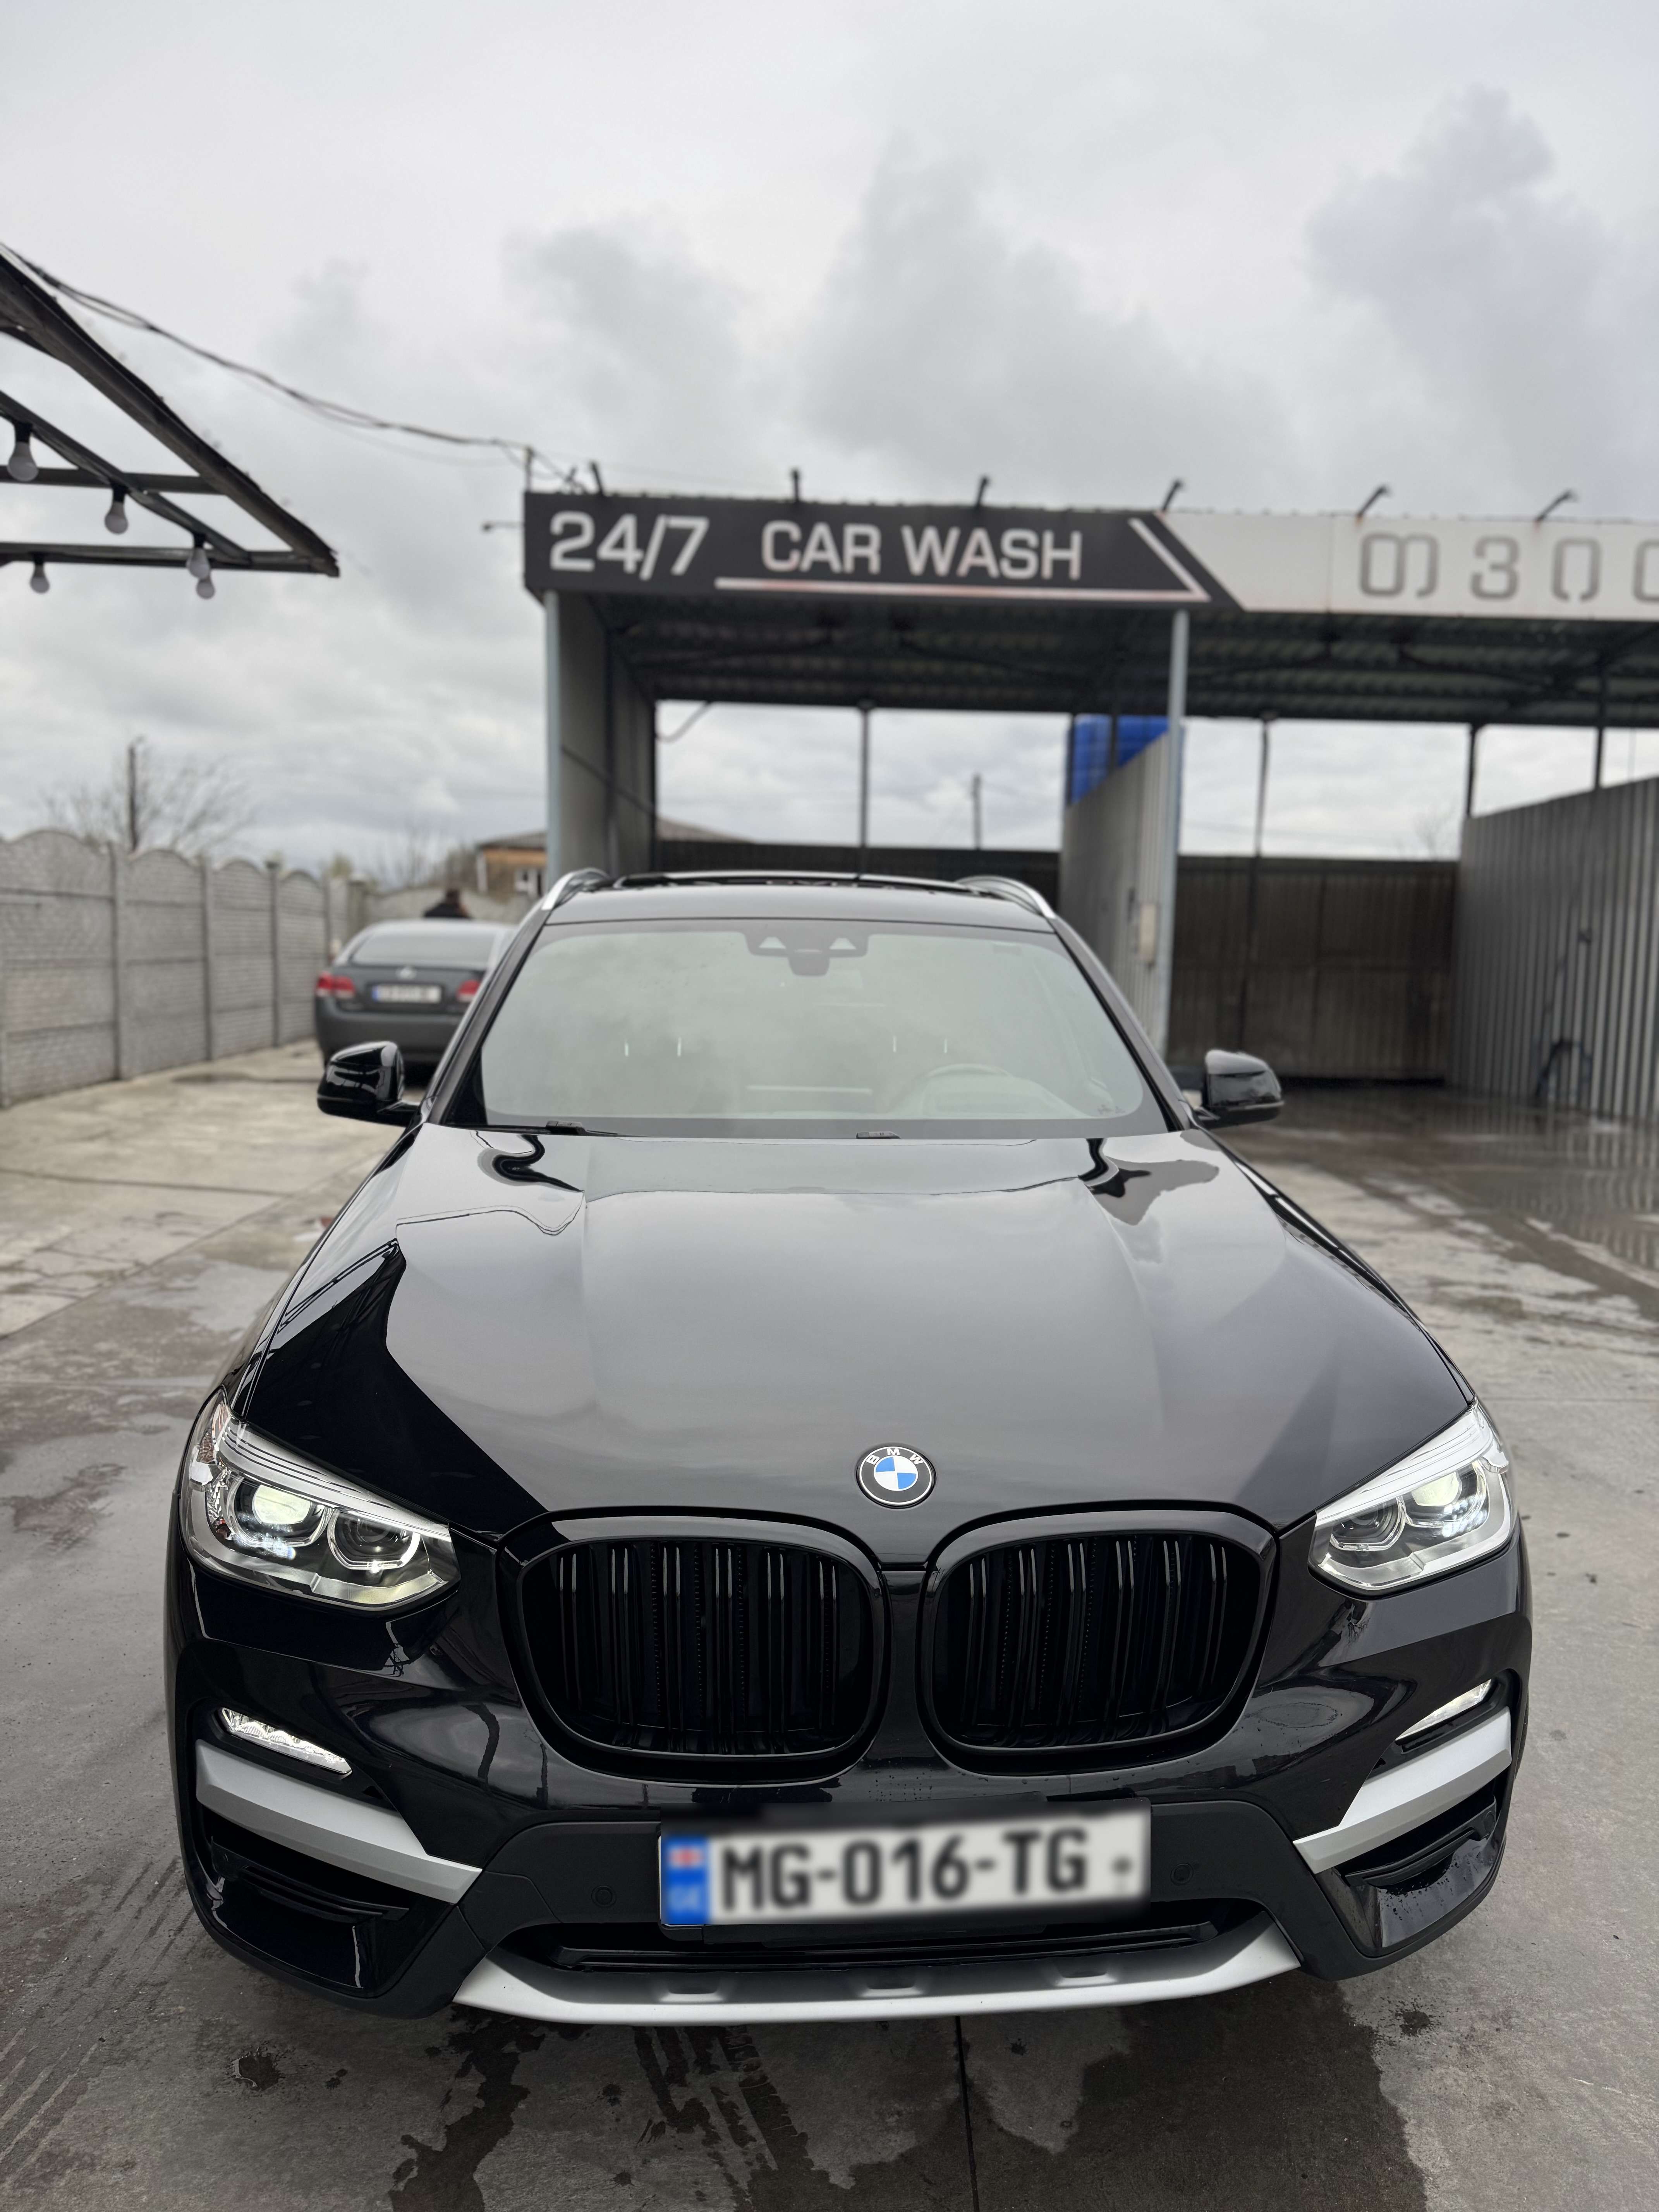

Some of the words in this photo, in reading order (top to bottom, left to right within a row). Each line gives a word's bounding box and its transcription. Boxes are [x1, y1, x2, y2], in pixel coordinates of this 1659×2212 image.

[550, 511, 709, 580] 24/7
[762, 520, 881, 574] CAR
[901, 525, 1082, 580] WASH
[866, 1448, 924, 1465] BMW
[721, 1827, 1087, 1911] MG-016-TG
